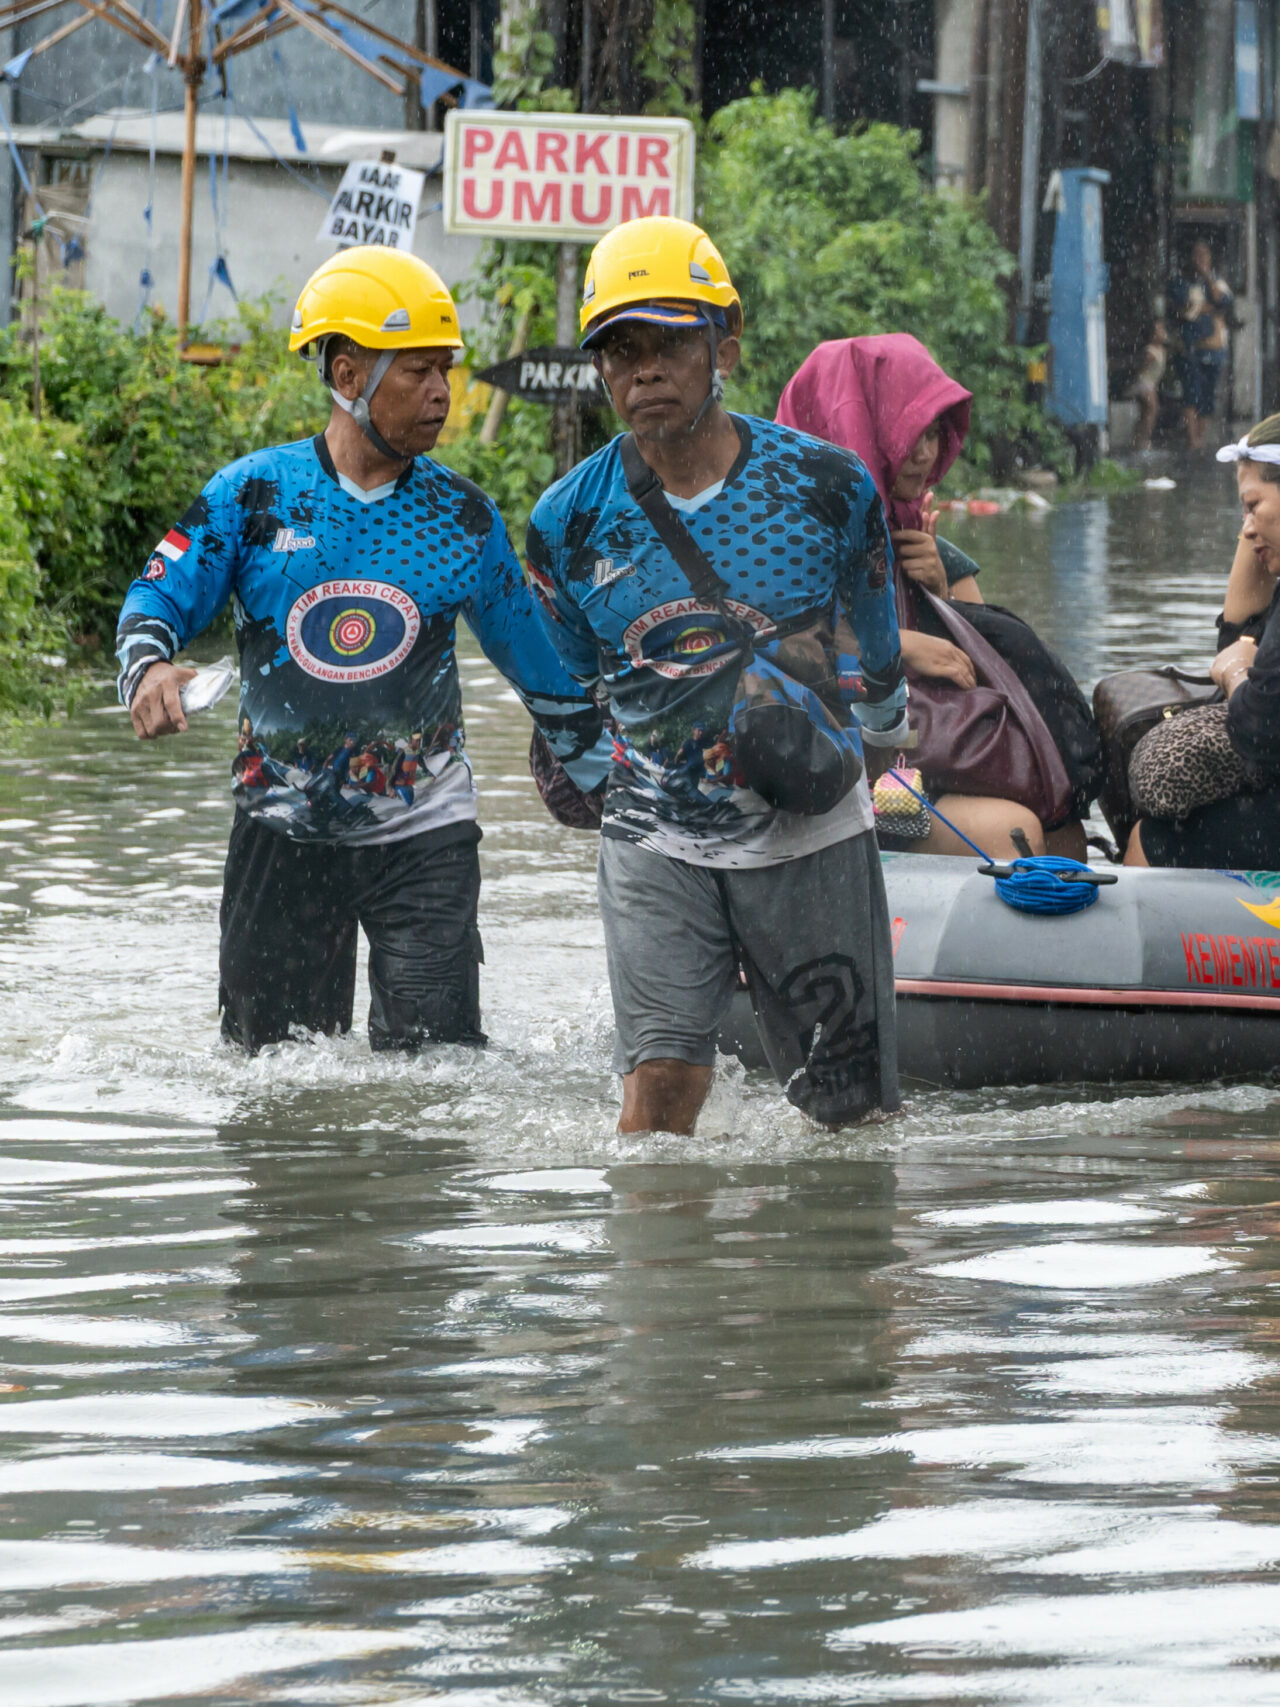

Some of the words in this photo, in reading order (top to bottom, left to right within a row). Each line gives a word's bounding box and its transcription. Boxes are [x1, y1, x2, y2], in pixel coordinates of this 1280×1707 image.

[463, 128, 671, 179] PARKIR
[462, 178, 671, 226] UMUM
[331, 216, 399, 249] BAYAR
[519, 361, 600, 392] PARKIR
[294, 589, 318, 614] TIM
[322, 582, 377, 598] REAKSI
[380, 587, 419, 622] CEPAT
[625, 618, 650, 642] TIM
[650, 600, 717, 624] REAKSI
[723, 601, 774, 629] EPA
[347, 663, 389, 681] BENCANA
